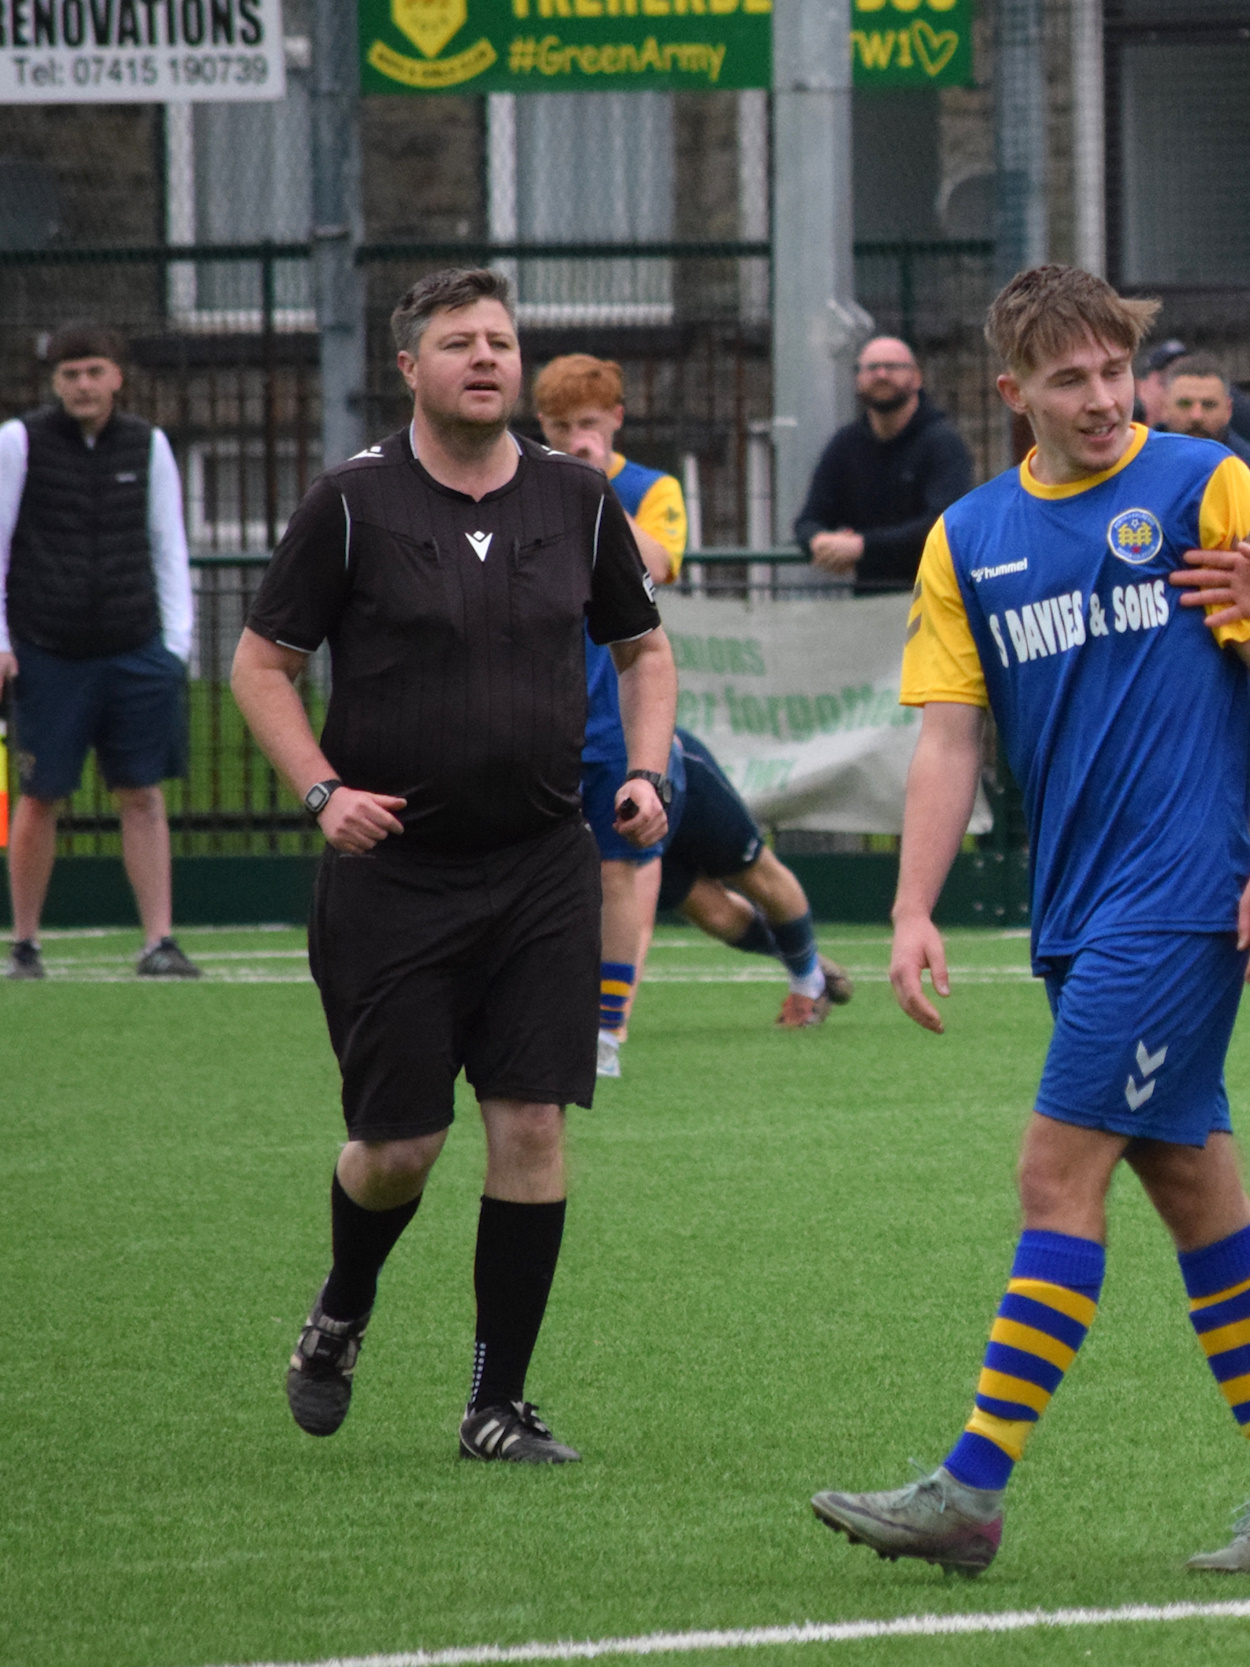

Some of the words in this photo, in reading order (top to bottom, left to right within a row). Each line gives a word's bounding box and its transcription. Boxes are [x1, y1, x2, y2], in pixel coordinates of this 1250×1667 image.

[14, 56, 63, 86] Tel:
[73, 57, 158, 86] 07415
[169, 55, 269, 84] 190739
[508, 35, 726, 82] #GreenArmy
[984, 557, 1028, 580] hummel
[1004, 590, 1086, 663] DAVIES
[1089, 592, 1109, 637] &
